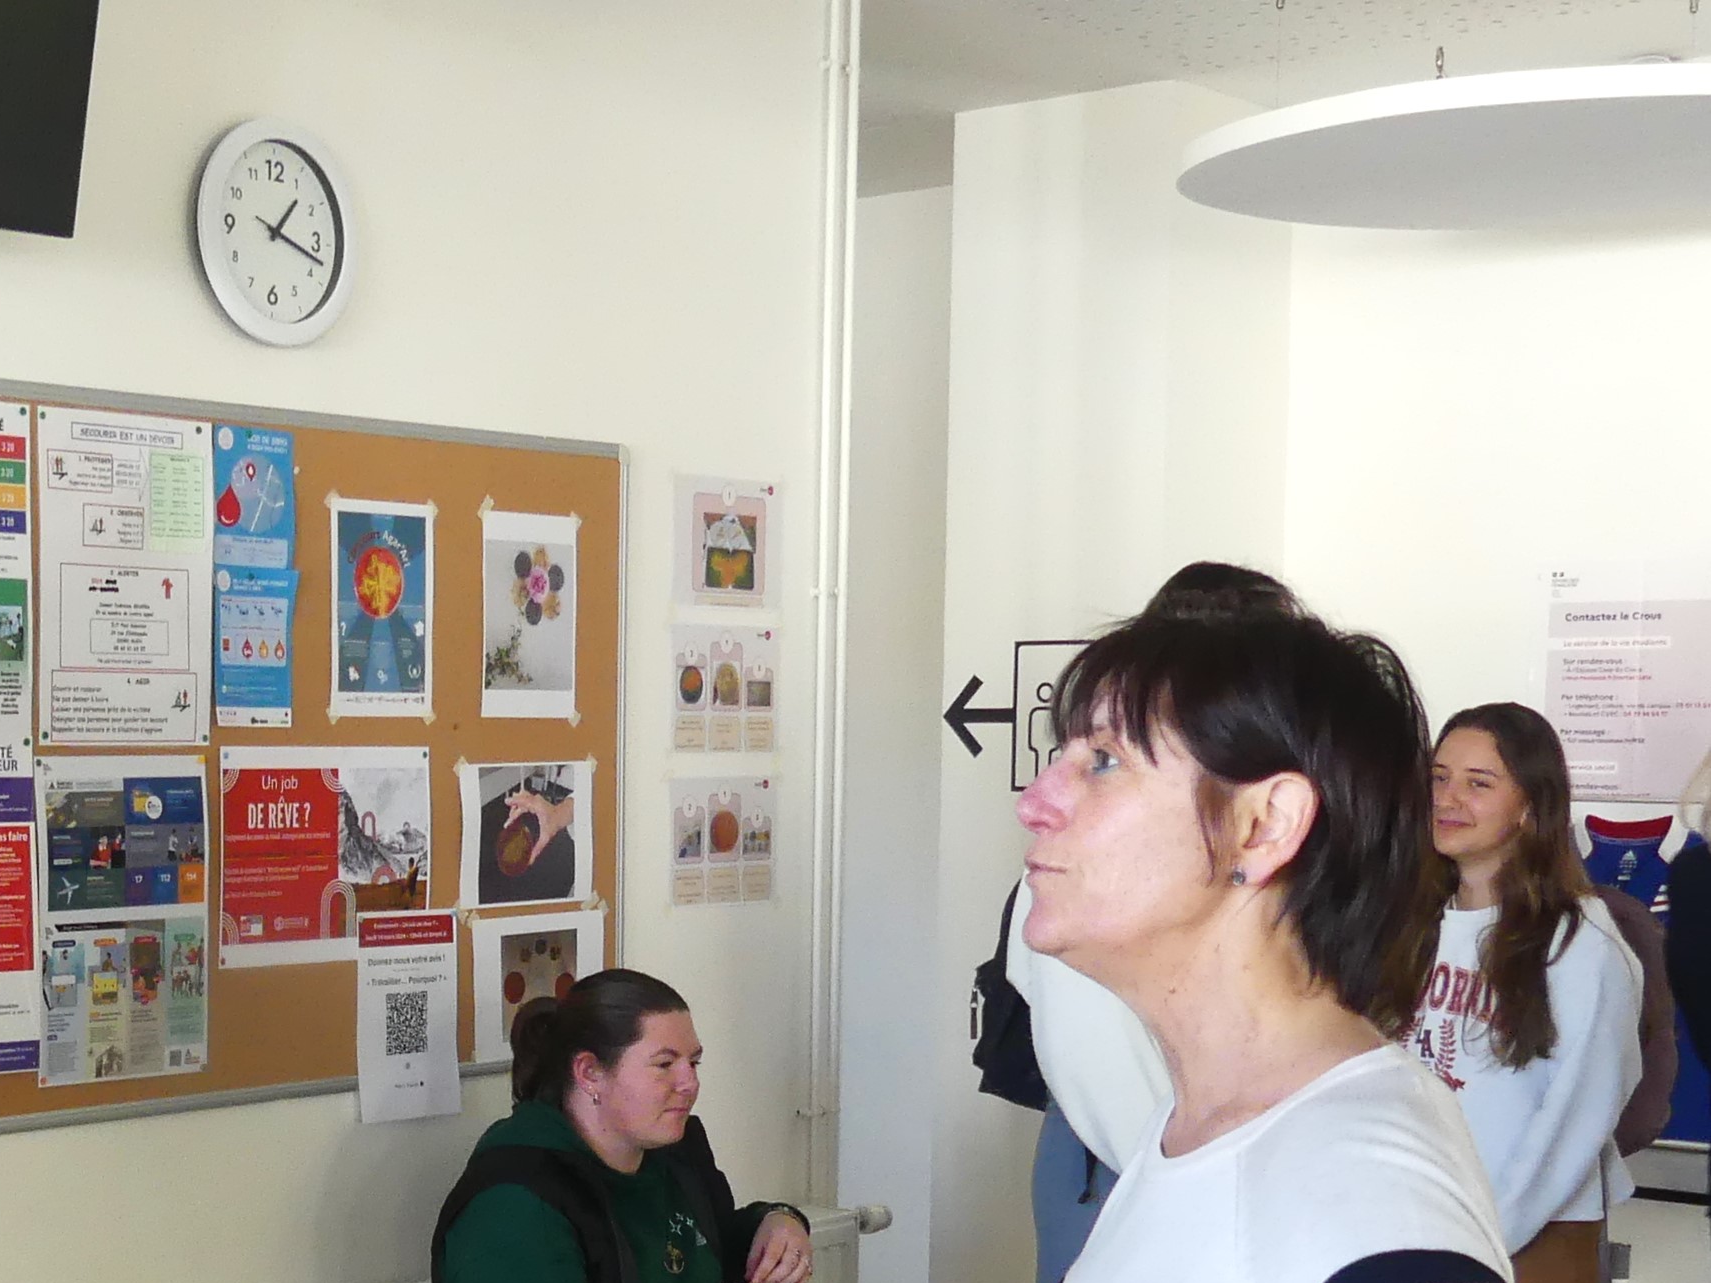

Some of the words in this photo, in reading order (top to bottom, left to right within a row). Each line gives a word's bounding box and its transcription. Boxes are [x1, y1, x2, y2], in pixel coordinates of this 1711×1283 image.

[248, 167, 259, 181] 11
[264, 159, 285, 183] 12
[294, 178, 299, 191] 1
[230, 186, 243, 200] 10
[308, 204, 315, 217] 2
[224, 213, 236, 234] 9
[310, 231, 322, 253] 3
[232, 250, 239, 263] 8
[306, 267, 314, 279] 4
[247, 276, 255, 288] 7
[266, 284, 279, 306] 6
[291, 285, 298, 297] 5
[80, 428, 118, 440] SECOURIR
[119, 431, 134, 441] EST
[148, 434, 175, 445] DEVOIR
[1564, 612, 1617, 623] Contactez
[1620, 611, 1630, 621] le
[1632, 610, 1662, 621] Crous
[1562, 658, 1576, 666] Sur
[1575, 692, 1613, 702] téléphone
[261, 774, 278, 791] Un
[280, 773, 299, 794] job
[247, 802, 263, 830] DE
[268, 796, 300, 829] RÊVE
[303, 802, 311, 829] ?
[7, 831, 29, 842] faire
[367, 956, 392, 967] Donnez
[411, 955, 428, 965] votre
[428, 954, 442, 964] avis
[408, 975, 438, 985] Pourquoi
